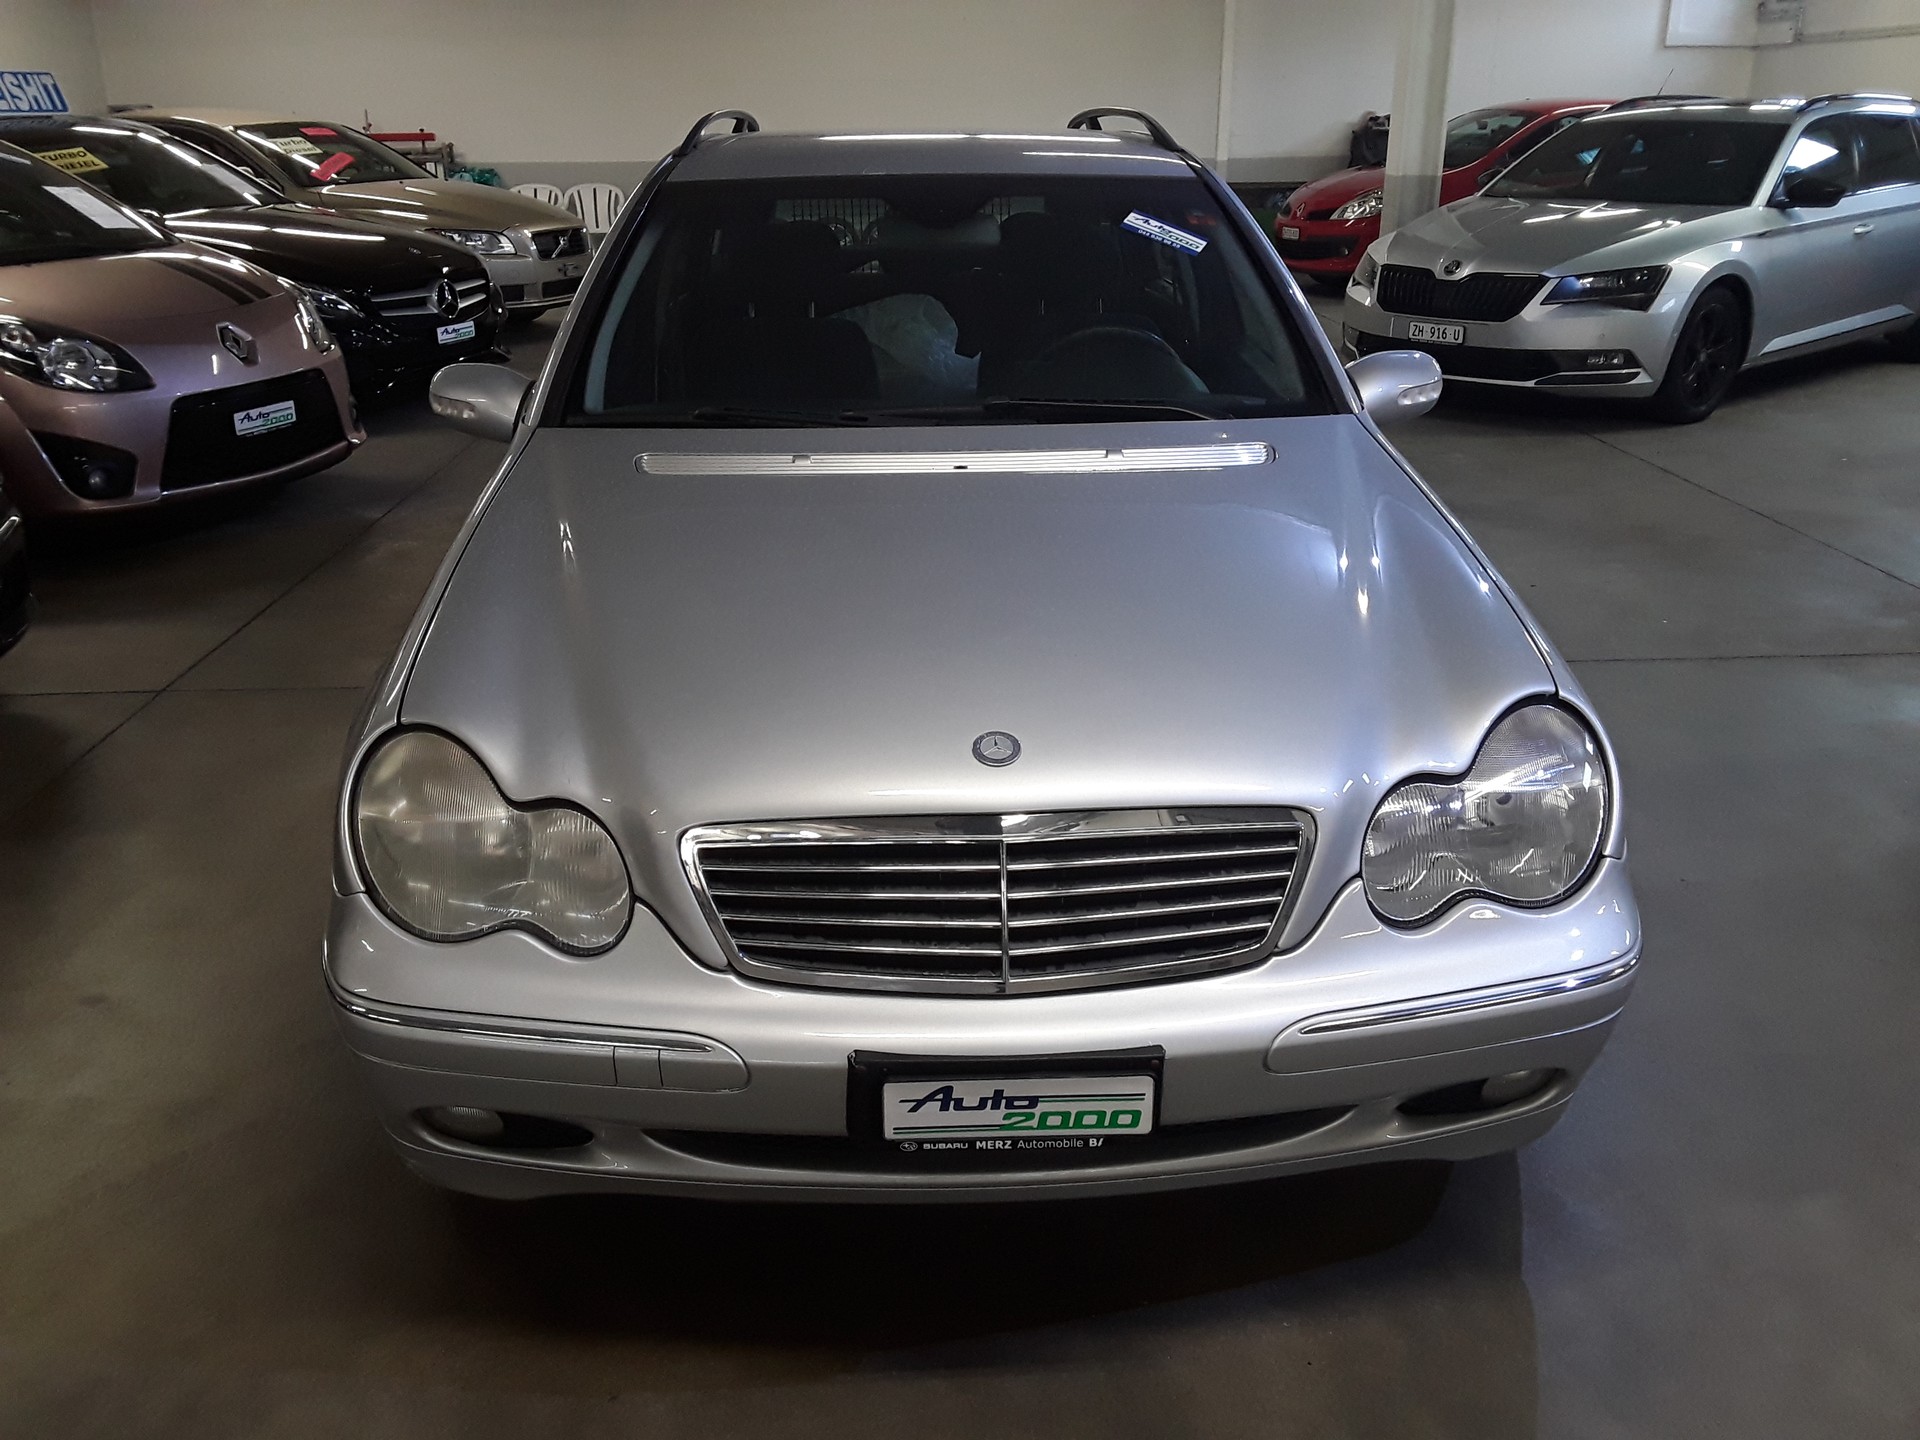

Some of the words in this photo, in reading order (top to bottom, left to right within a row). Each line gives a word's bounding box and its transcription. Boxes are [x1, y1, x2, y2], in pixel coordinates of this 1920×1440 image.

[1412, 324, 1424, 337] ZH
[1430, 326, 1448, 340] 916
[1453, 328, 1461, 341] U
[238, 411, 270, 424] Auto
[263, 413, 293, 425] 2000
[900, 1085, 1040, 1112] Auto
[998, 1109, 1142, 1130] 2000
[922, 1142, 968, 1150] SUBARU
[976, 1140, 1013, 1150] MERZ
[1017, 1138, 1085, 1149] Automobile
